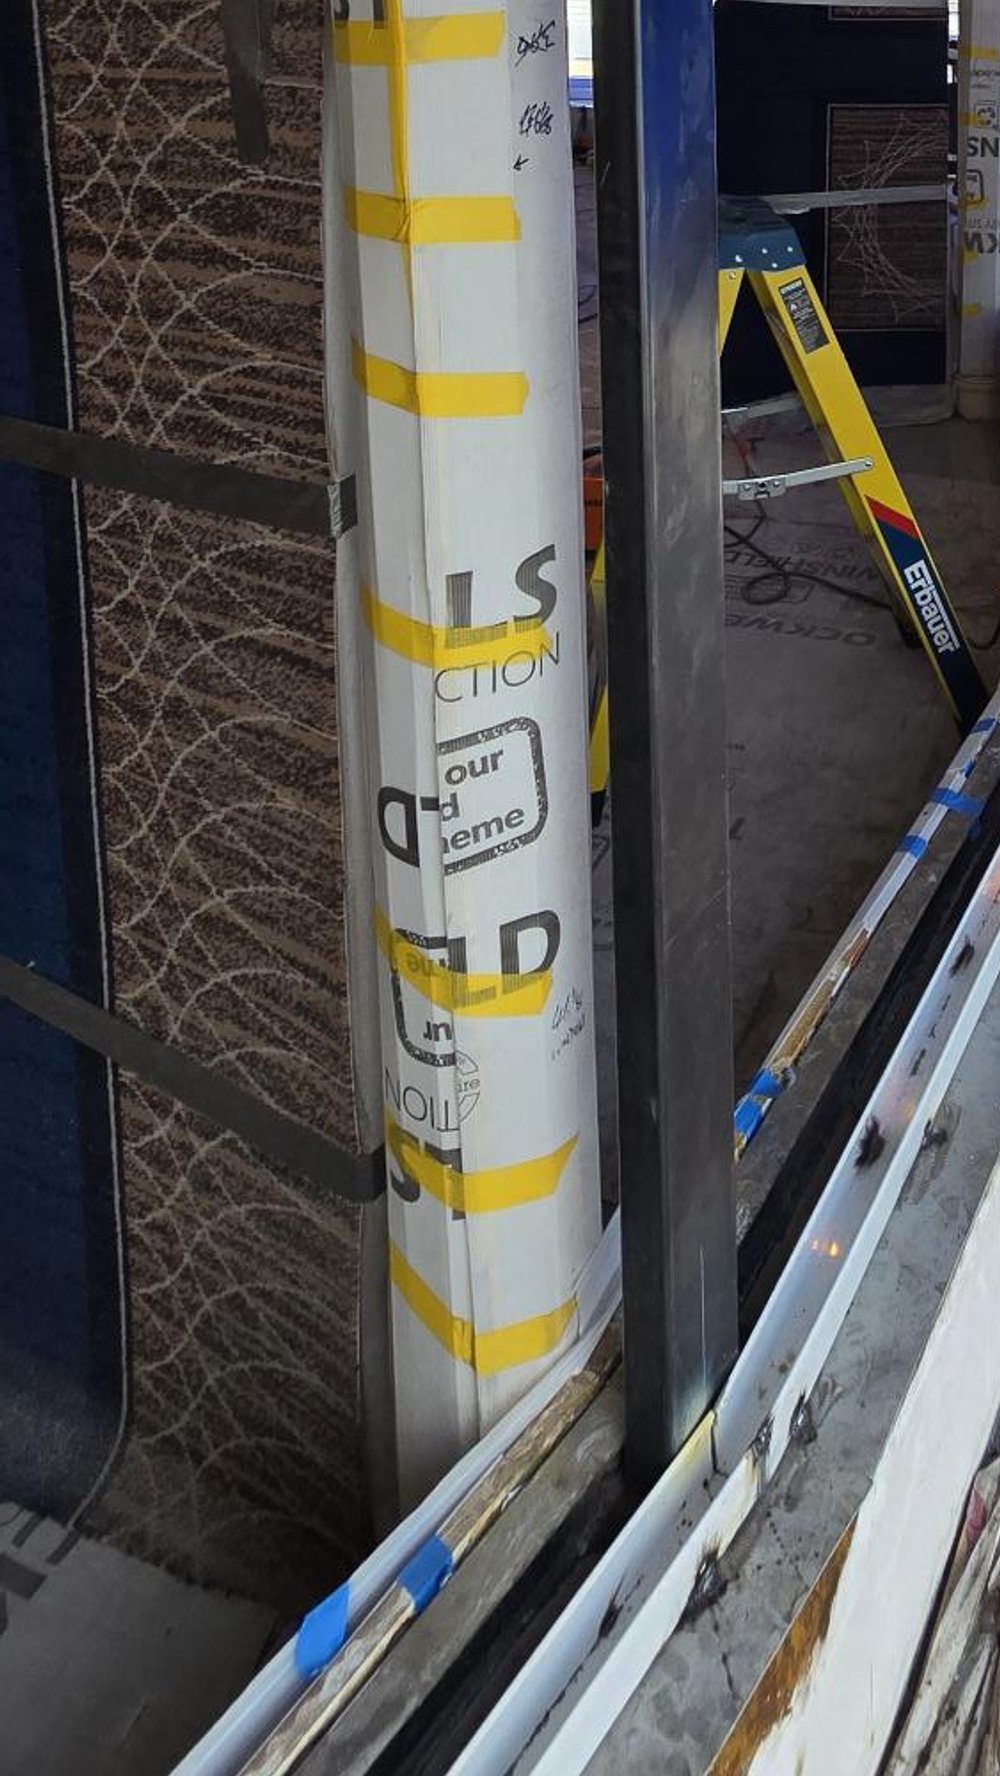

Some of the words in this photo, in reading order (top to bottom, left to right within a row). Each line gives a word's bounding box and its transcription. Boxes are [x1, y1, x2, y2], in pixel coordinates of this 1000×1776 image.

[445, 543, 557, 649] LS
[904, 559, 957, 654] Erbauer
[444, 749, 504, 786] our
